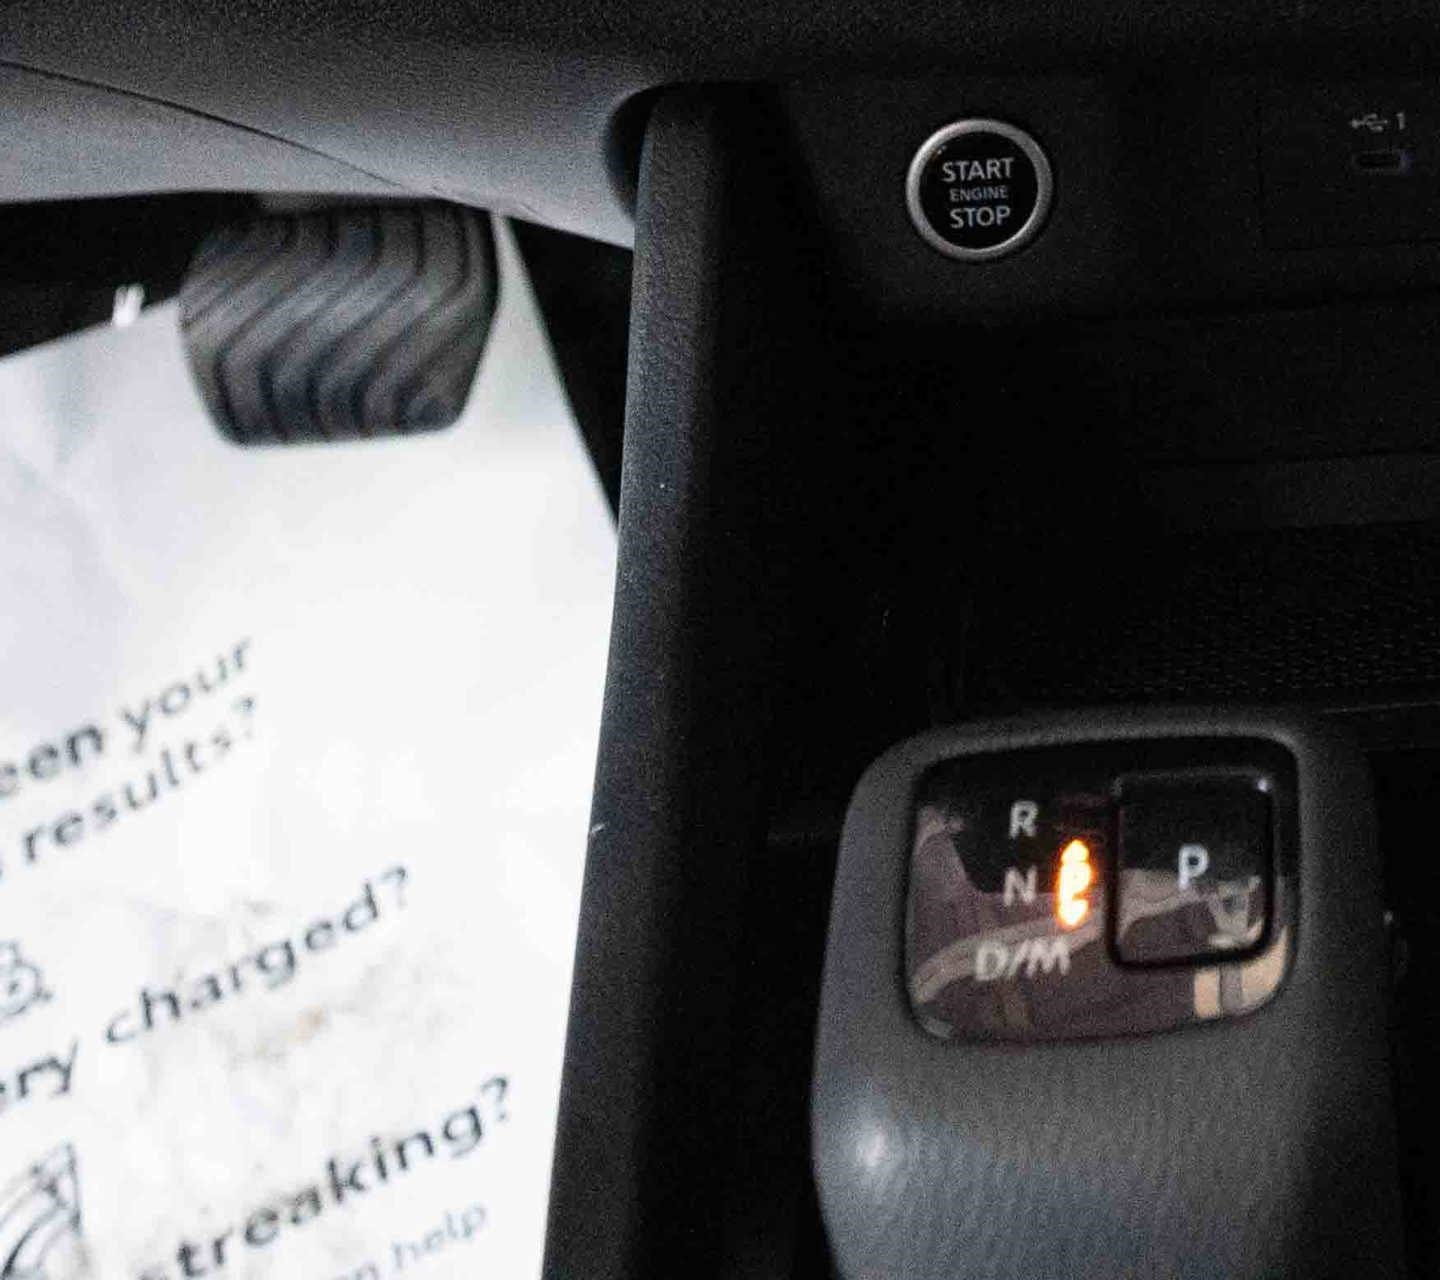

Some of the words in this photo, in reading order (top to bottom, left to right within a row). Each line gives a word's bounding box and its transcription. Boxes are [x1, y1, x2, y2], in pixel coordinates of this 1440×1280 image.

[1395, 111, 1406, 130] 1
[942, 157, 1014, 182] START
[949, 185, 1008, 202] ENGINE
[949, 205, 1010, 229] STOP
[121, 636, 254, 753] your
[22, 695, 258, 865] results?
[1010, 800, 1038, 839] R
[1003, 865, 1037, 907] N
[1178, 843, 1209, 891] P
[103, 865, 410, 1045] charged?
[975, 937, 1070, 981] D/M
[140, 1074, 512, 1280] treaking?
